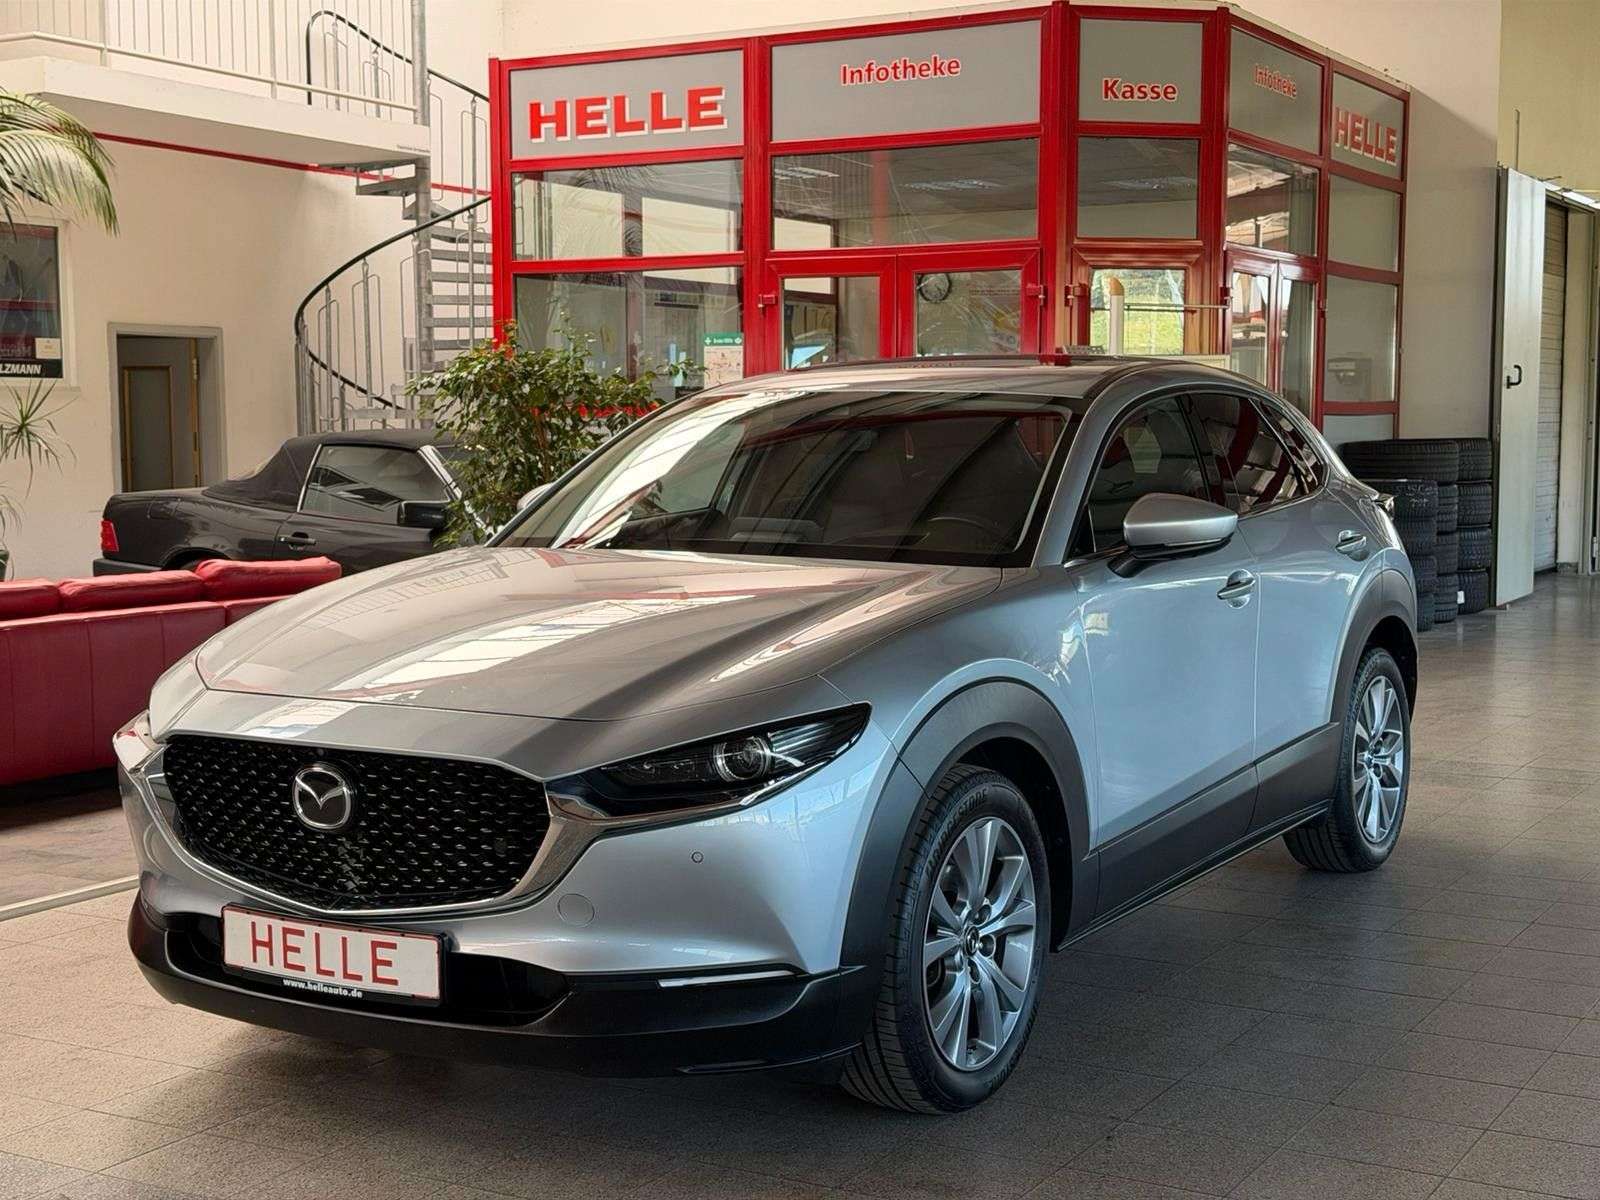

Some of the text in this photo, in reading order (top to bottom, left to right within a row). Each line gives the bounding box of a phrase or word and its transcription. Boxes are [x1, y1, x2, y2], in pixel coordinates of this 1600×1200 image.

[841, 55, 961, 86] Infotheke
[1254, 65, 1297, 98] Infotheke
[1102, 78, 1178, 103] Kasse
[529, 87, 728, 143] HELLE
[1334, 107, 1397, 165] HELLE
[251, 921, 398, 986] HELLE
[283, 977, 363, 999] www.helleauto.de
